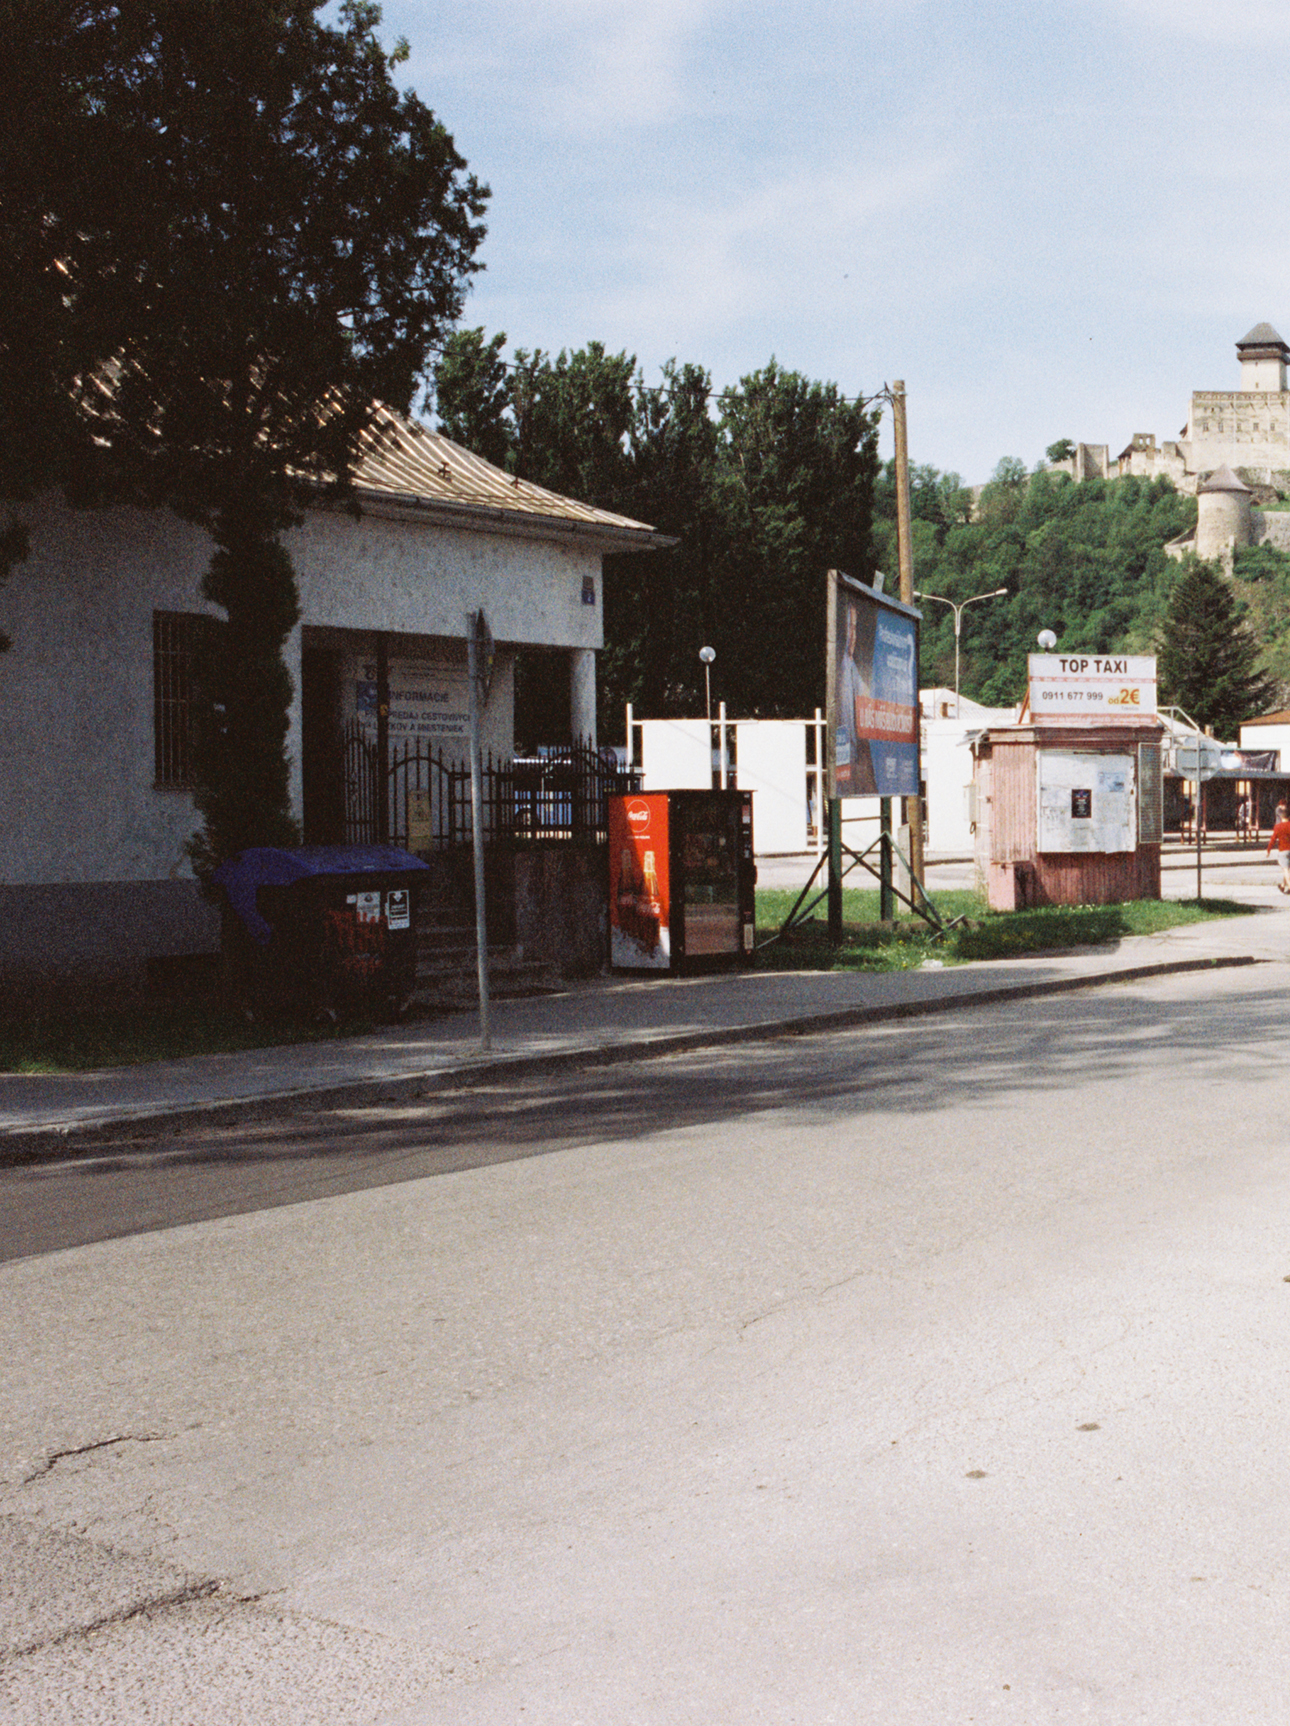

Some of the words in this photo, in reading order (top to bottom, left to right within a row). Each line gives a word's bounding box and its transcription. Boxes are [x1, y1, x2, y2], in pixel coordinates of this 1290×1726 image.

[1059, 658, 1089, 673] TOP
[1094, 659, 1128, 674] TAXI
[1042, 691, 1064, 700] 0911
[1067, 691, 1084, 701] 677
[1086, 692, 1104, 701] 999
[1120, 688, 1140, 705] 2€
